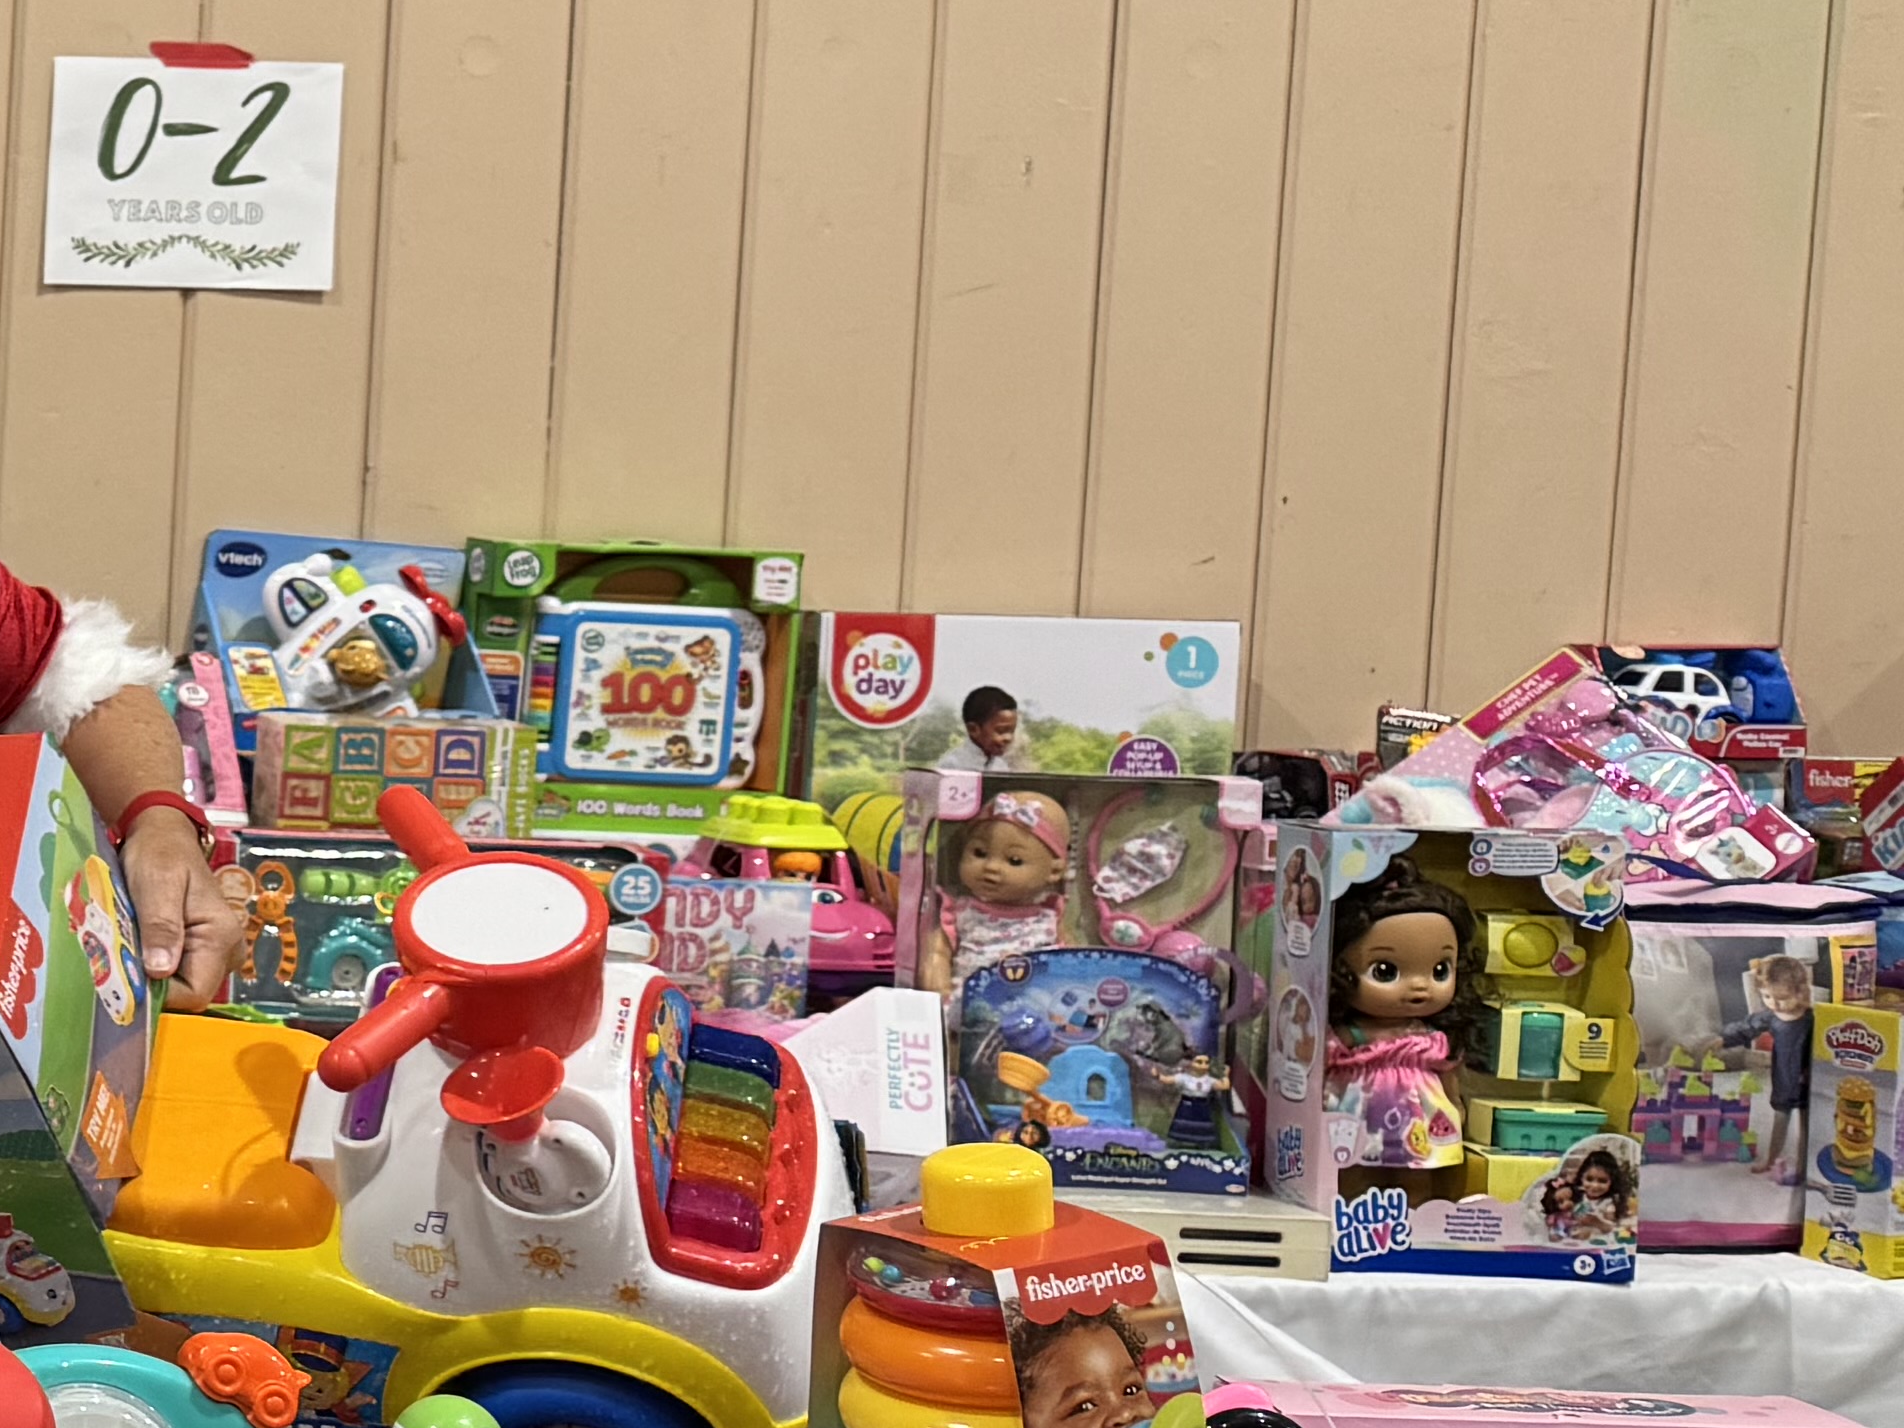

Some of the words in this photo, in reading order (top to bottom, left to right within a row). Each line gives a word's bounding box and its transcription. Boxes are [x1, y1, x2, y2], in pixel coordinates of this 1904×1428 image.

[97, 77, 290, 186] 0-2
[107, 198, 201, 223] YEARS
[206, 201, 263, 224] OLD
[217, 550, 265, 566] vtech
[853, 649, 914, 679] play
[1187, 647, 1196, 667] 1
[601, 673, 695, 716] 100
[856, 672, 906, 700] day
[948, 786, 969, 802] 2+
[622, 876, 651, 894] 25
[1586, 1021, 1602, 1042] 9
[887, 1027, 903, 1110] PERFECTLY
[1335, 1189, 1407, 1231] baby
[1026, 1263, 1146, 1302] fisher-price
